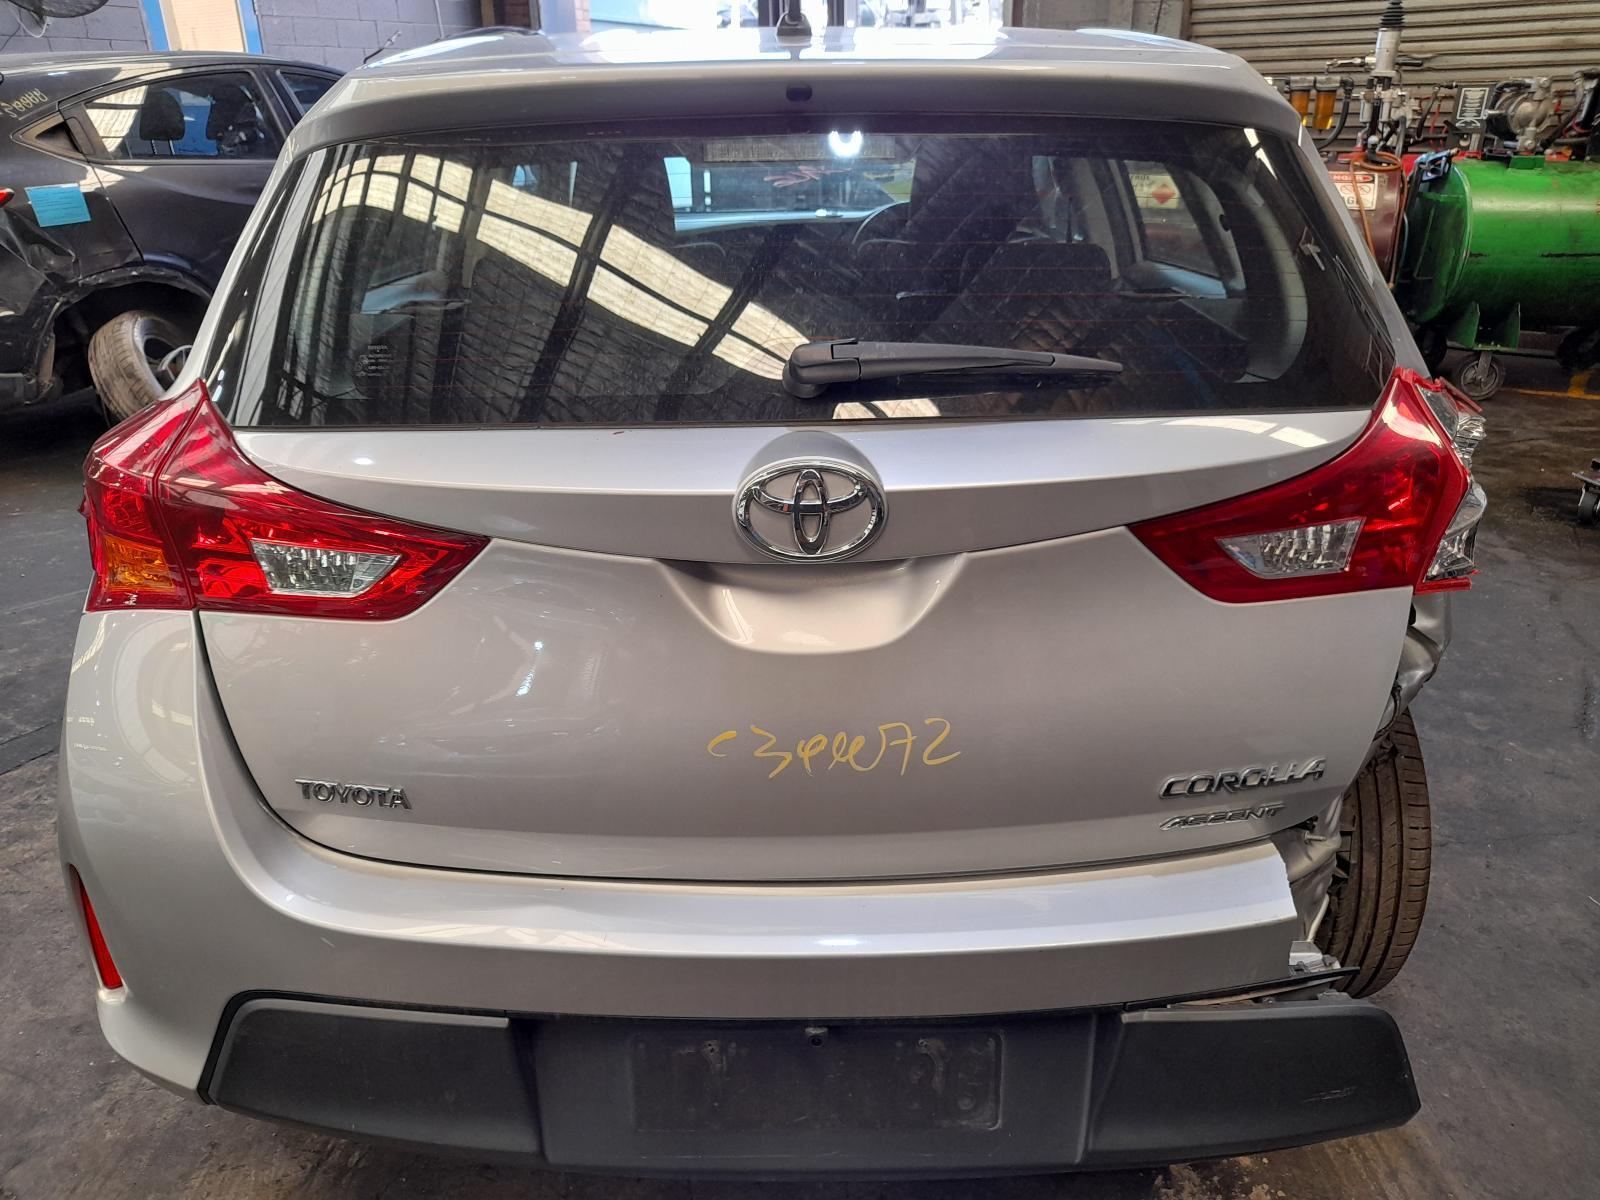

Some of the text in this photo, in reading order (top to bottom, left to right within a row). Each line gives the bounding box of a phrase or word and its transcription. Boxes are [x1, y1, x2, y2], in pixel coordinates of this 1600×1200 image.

[294, 778, 412, 811] TOYOTA
[1159, 757, 1326, 799] COROLLA
[1159, 801, 1286, 831] ASCENT
